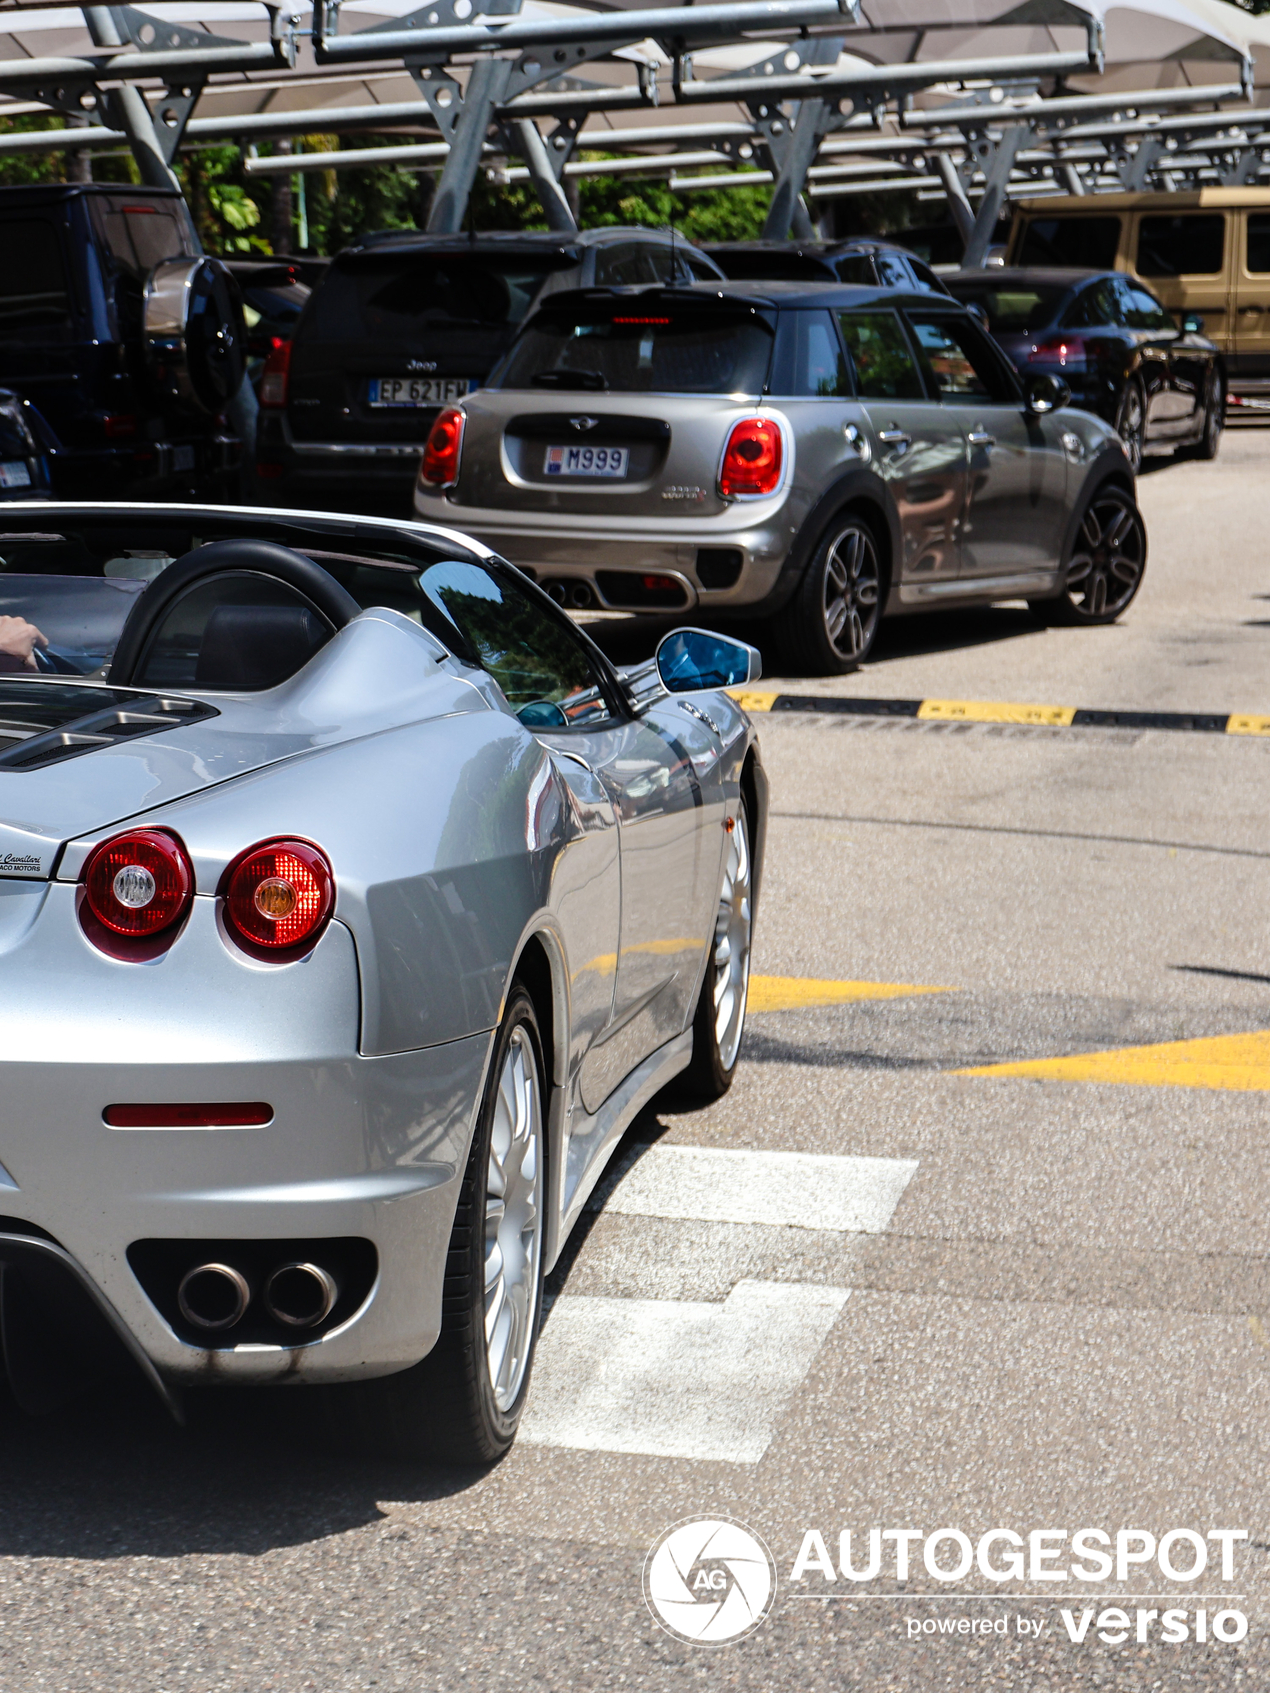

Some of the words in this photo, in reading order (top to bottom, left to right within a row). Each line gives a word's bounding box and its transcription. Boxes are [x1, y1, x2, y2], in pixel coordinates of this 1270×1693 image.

[407, 360, 437, 371] Jeep
[379, 381, 403, 400] EP
[568, 449, 622, 470] M999
